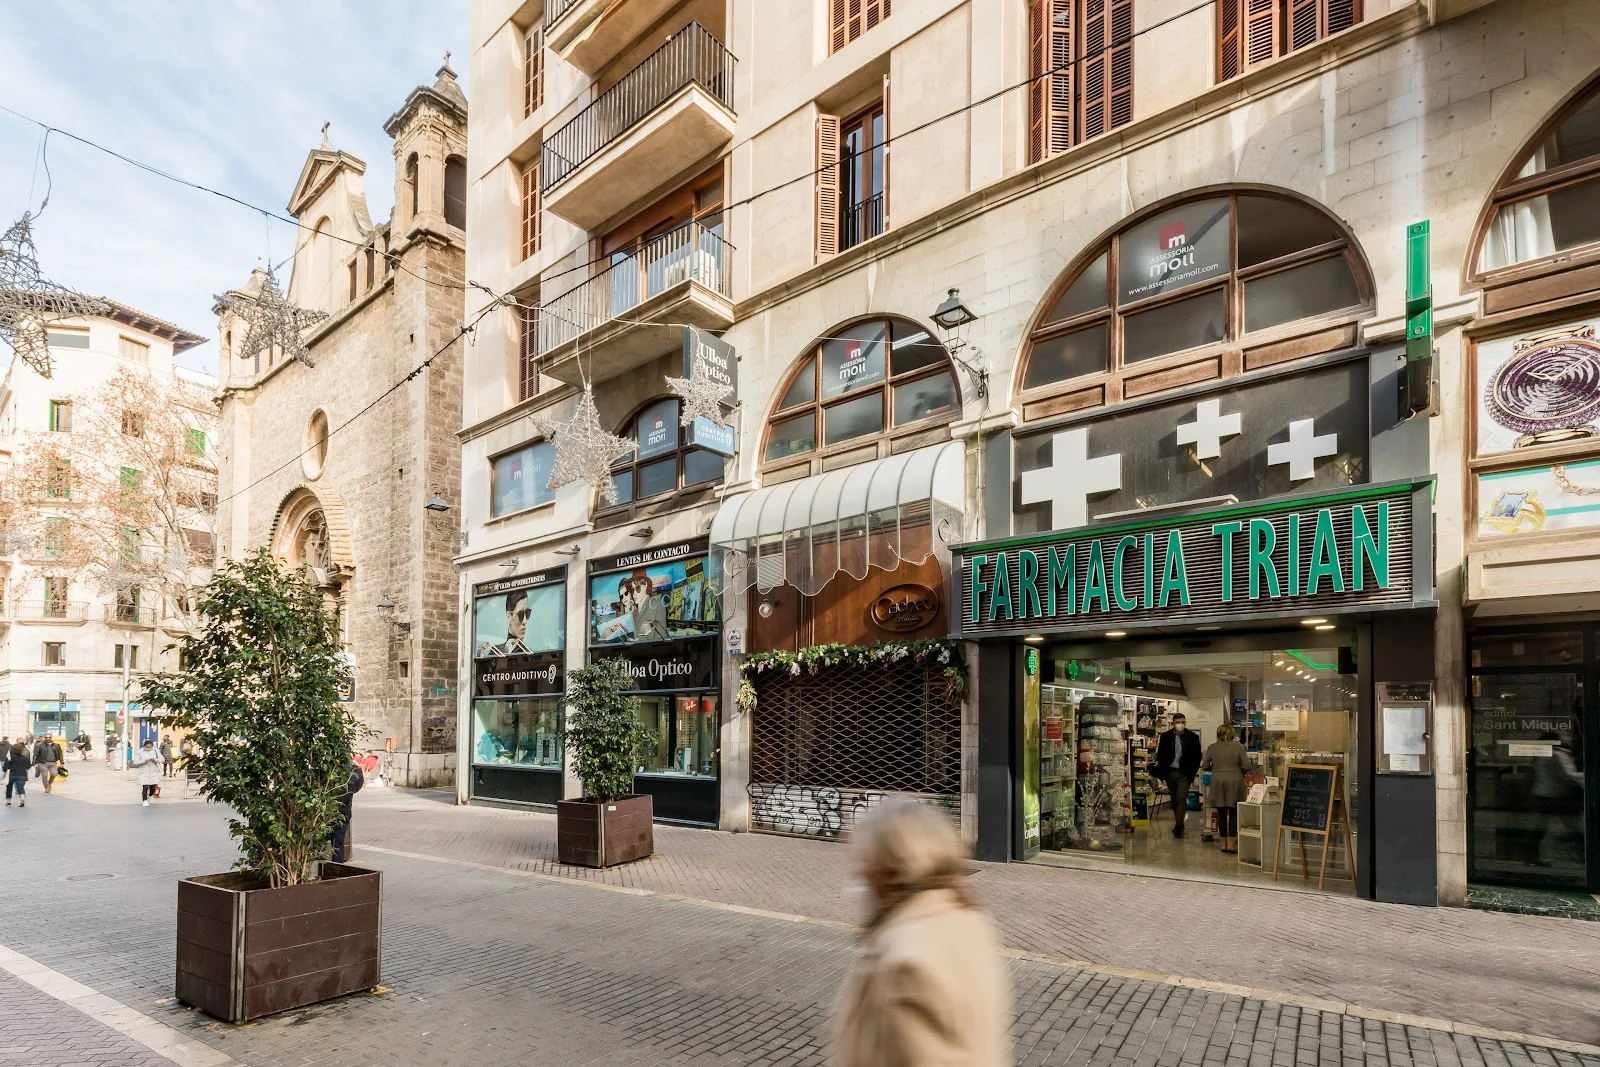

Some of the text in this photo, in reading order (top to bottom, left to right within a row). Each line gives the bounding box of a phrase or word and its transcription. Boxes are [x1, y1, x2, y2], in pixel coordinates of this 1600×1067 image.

[1150, 244, 1195, 263] ASSESSORIA
[1149, 252, 1195, 278] moll
[1128, 262, 1219, 296] www.assessoriamoll.com
[699, 342, 727, 370] Ulloa
[839, 362, 867, 381] moll
[648, 432, 667, 446] moll
[697, 430, 725, 445] AUDITIVO
[702, 424, 725, 438] CENTRO
[616, 543, 690, 568] LENTES DE CONTACTO
[971, 501, 1389, 623] FARMACIA TRIAN
[482, 670, 548, 682] CENTRO AUDITIVO
[648, 658, 693, 682] Optico
[1483, 707, 1516, 717] edifici
[1483, 719, 1572, 732] Sant Miquel
